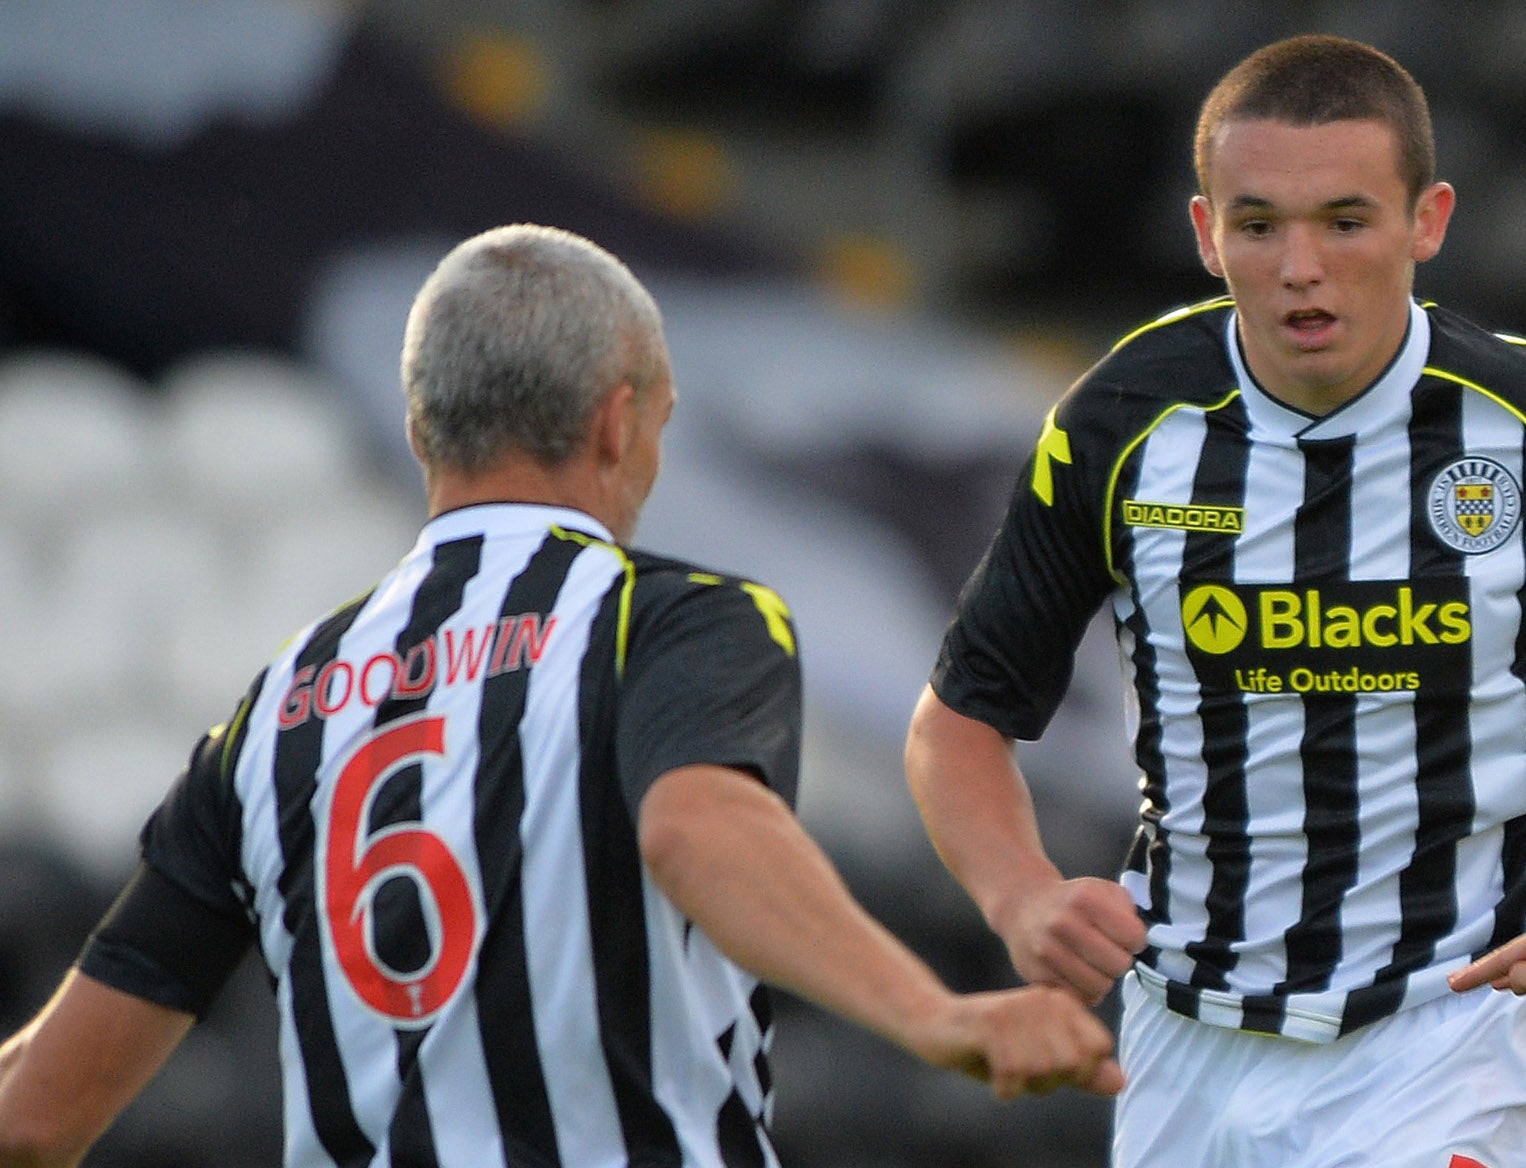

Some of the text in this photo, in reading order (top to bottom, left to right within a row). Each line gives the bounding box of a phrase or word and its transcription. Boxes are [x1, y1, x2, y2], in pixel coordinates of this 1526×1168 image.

[1128, 503, 1241, 530] DIADORA
[1260, 587, 1472, 649] Blacks
[278, 612, 557, 730] GOODWIN
[1235, 668, 1420, 693] Life Outdoors
[323, 714, 481, 1024] 6
